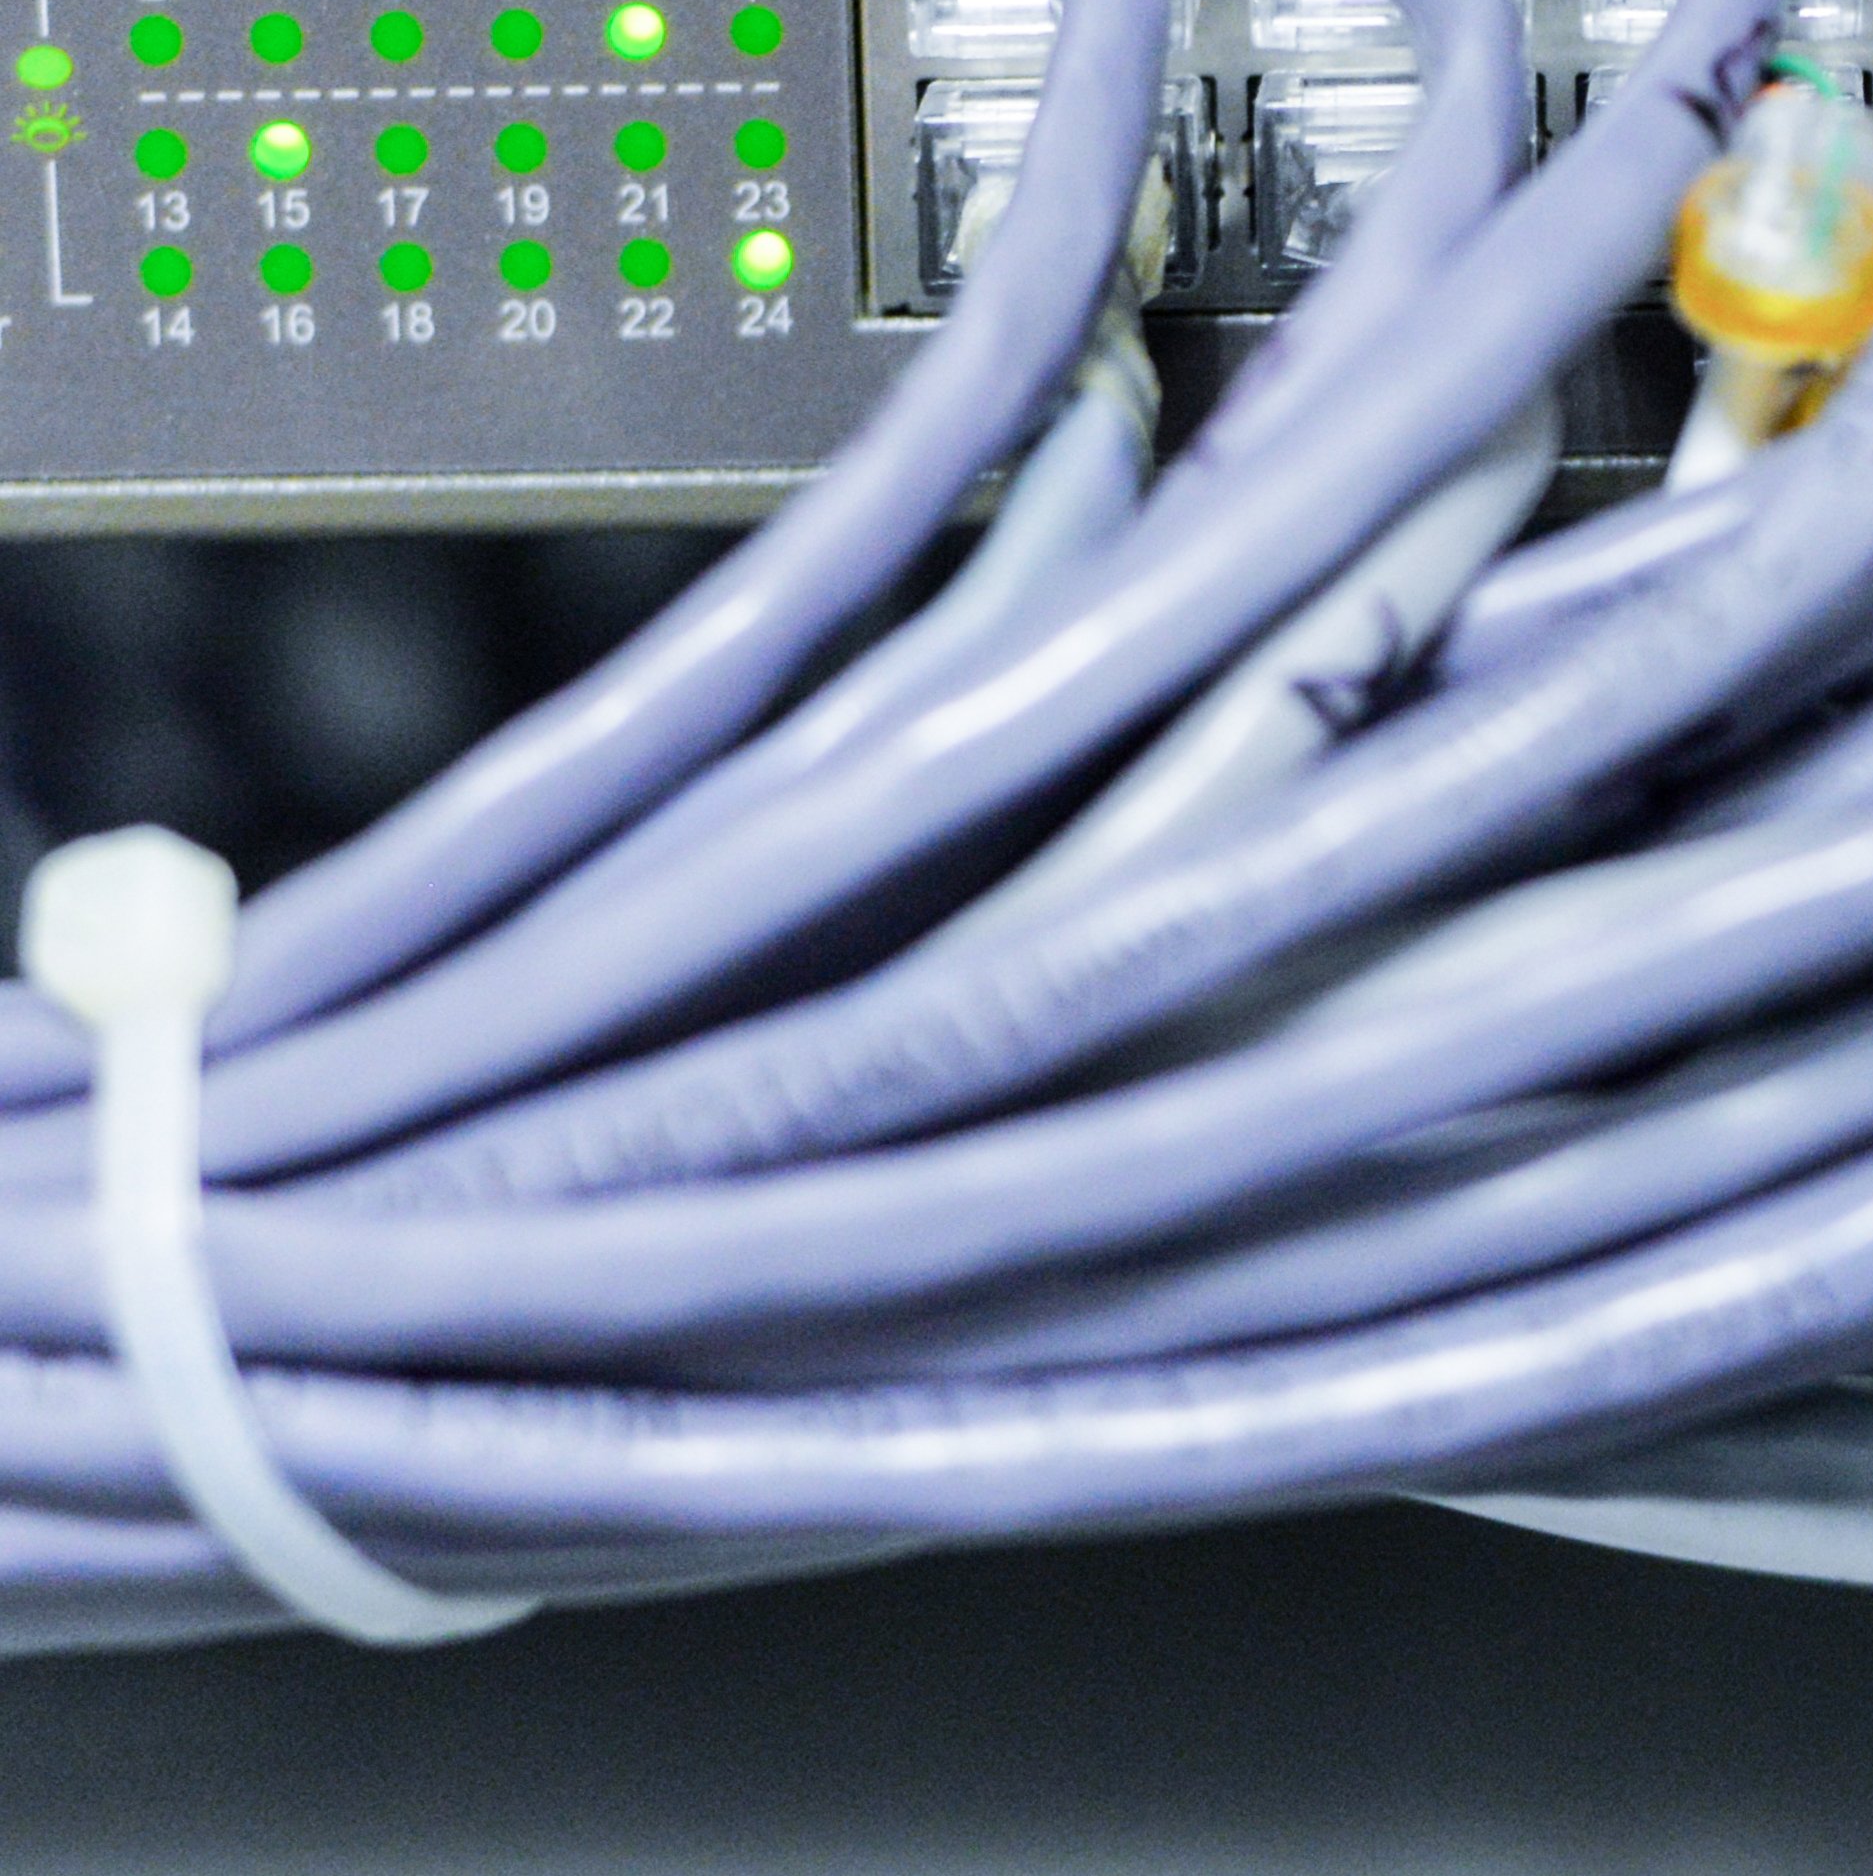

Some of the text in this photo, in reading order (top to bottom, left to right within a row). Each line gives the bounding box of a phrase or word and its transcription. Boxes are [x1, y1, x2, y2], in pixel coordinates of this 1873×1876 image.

[136, 190, 191, 232] 13
[257, 188, 311, 229] 15
[378, 186, 429, 226] 17
[498, 184, 550, 225] 19
[618, 182, 669, 224] 21
[735, 180, 790, 221] 23
[142, 306, 195, 346] 14
[261, 302, 315, 345] 16
[382, 301, 435, 343] 18
[499, 298, 556, 341] 20
[620, 297, 674, 338] 22
[738, 295, 793, 336] 24
